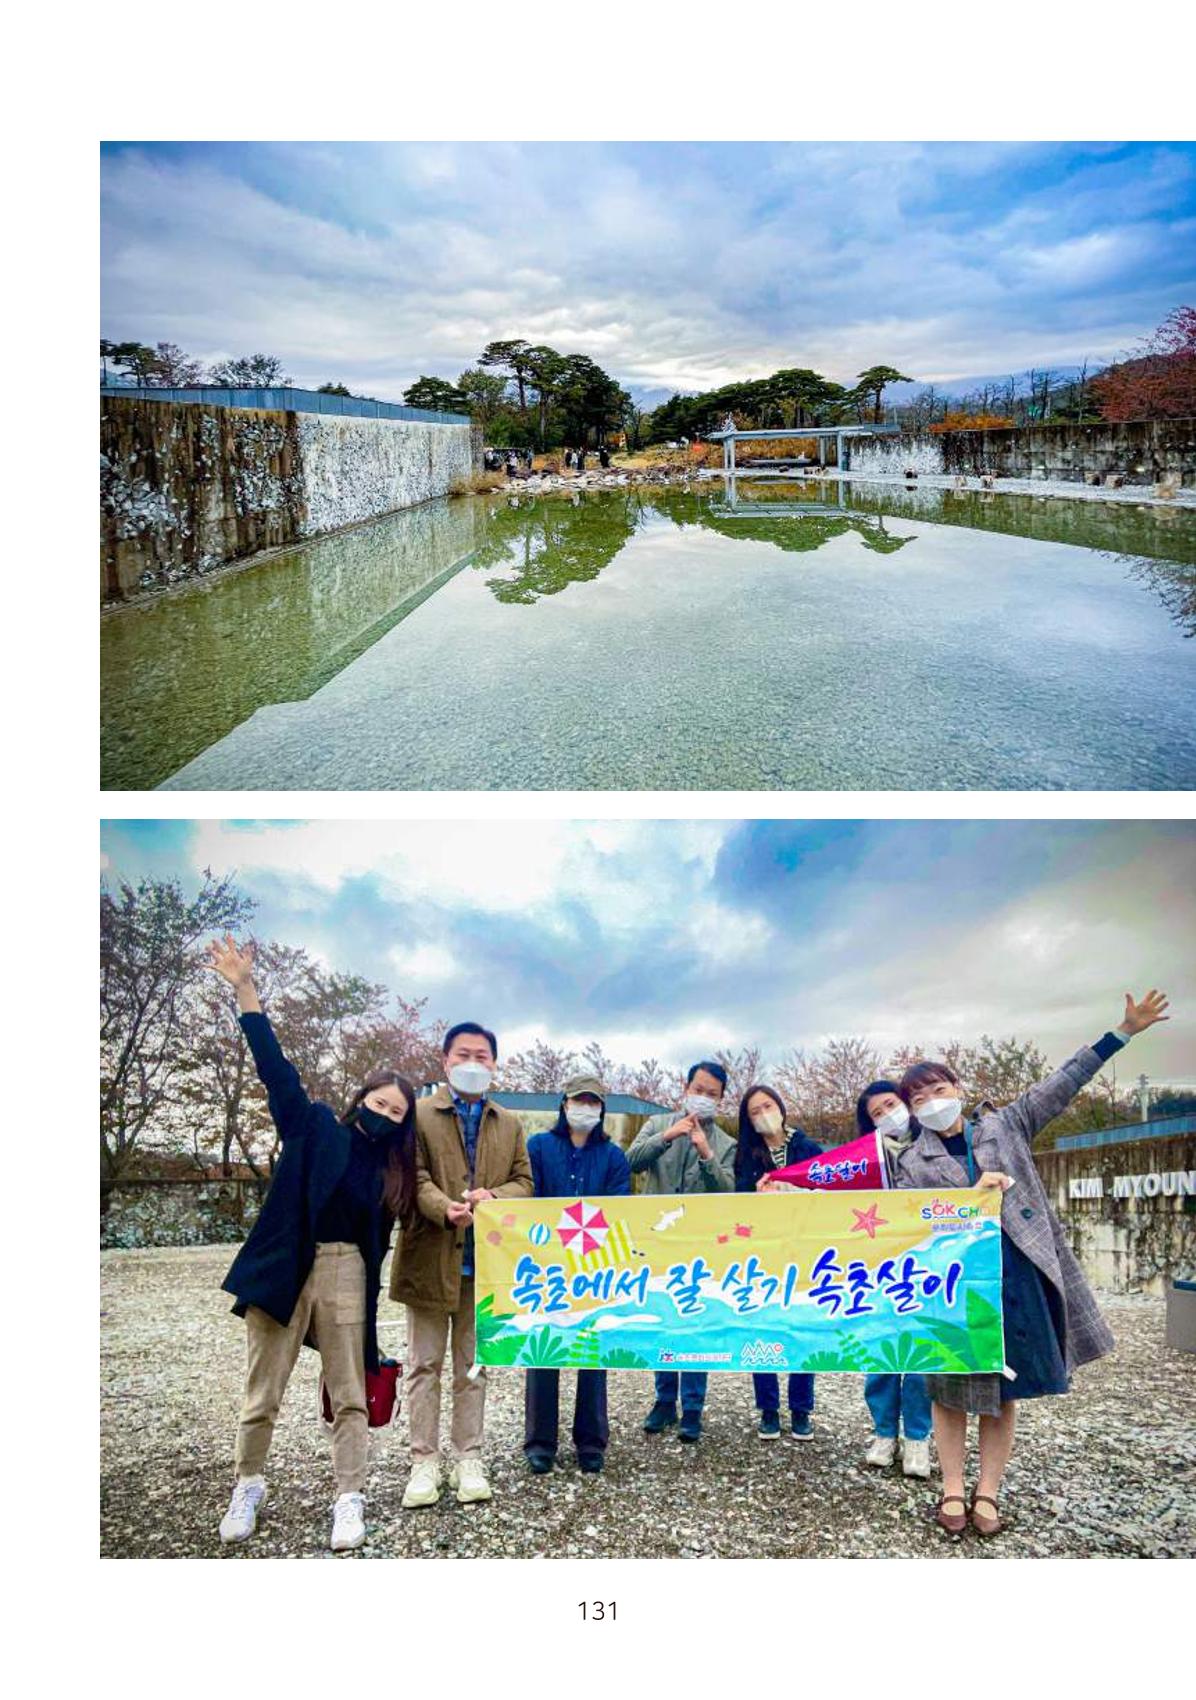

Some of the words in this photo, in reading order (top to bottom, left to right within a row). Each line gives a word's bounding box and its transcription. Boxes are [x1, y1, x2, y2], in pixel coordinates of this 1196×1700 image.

[1068, 1178, 1105, 1199] KIM
[1112, 1170, 1196, 1199] MYOUN
[512, 1256, 650, 1314] 속초에서
[666, 1259, 712, 1315] 잘
[721, 1257, 798, 1313] 살기
[808, 1249, 962, 1316] 속초살이
[578, 1600, 616, 1621] 131
